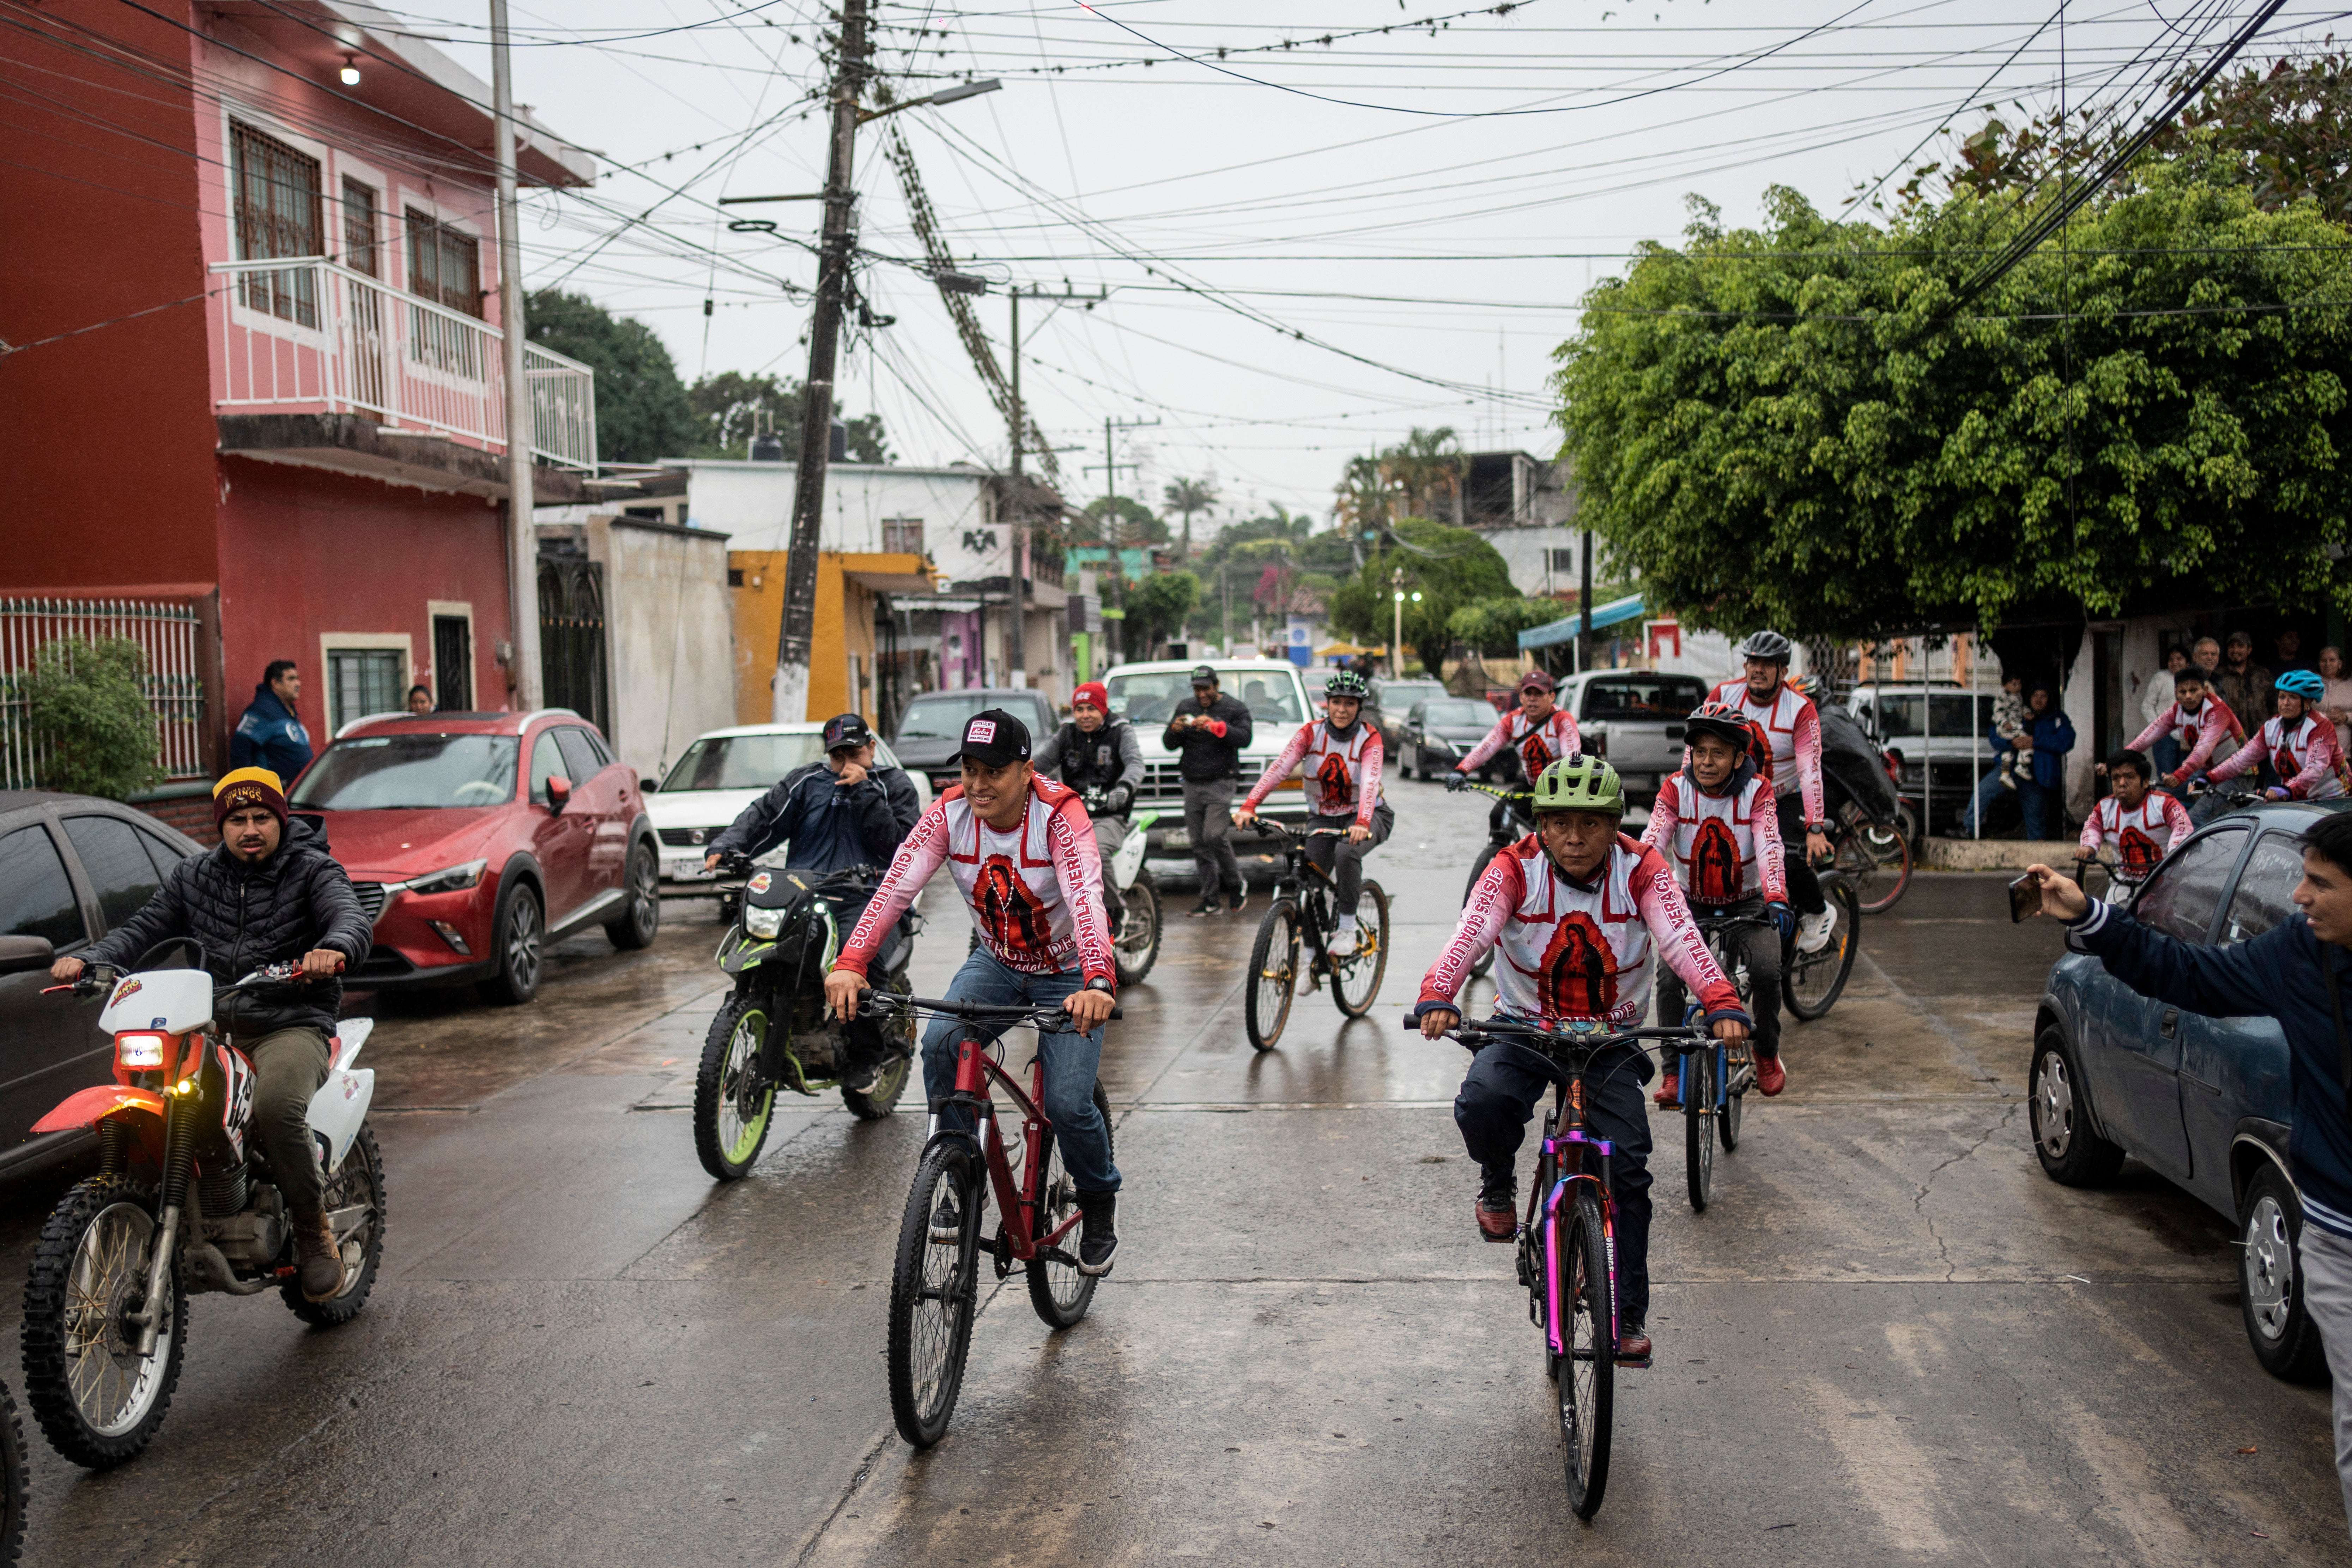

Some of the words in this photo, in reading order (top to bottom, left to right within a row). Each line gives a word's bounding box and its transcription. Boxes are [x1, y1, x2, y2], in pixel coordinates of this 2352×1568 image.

[225, 789, 262, 809] VIKINGS
[1046, 933, 1076, 958] DE
[1607, 1000, 1637, 1023] DE
